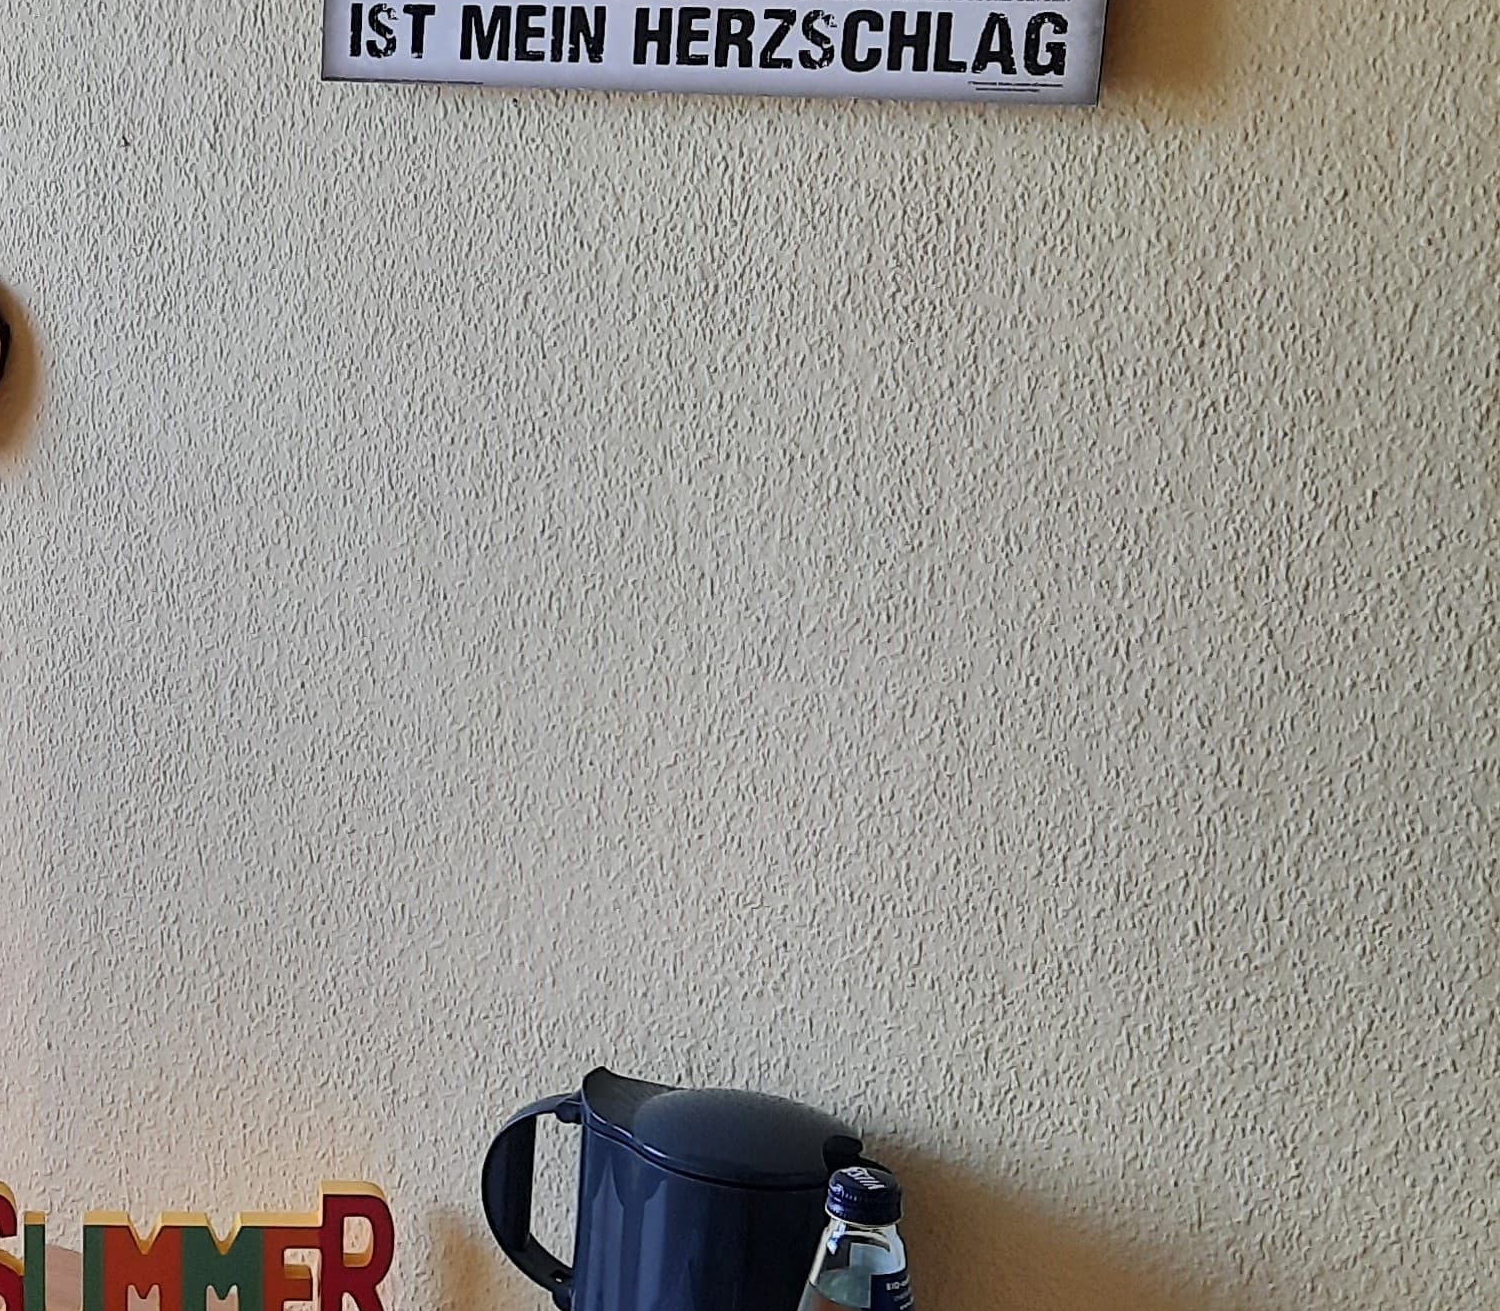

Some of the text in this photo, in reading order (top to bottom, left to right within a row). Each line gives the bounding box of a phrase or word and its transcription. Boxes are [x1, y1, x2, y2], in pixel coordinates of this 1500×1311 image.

[349, 2, 1069, 77] IST MEIN HERZSCHLAG
